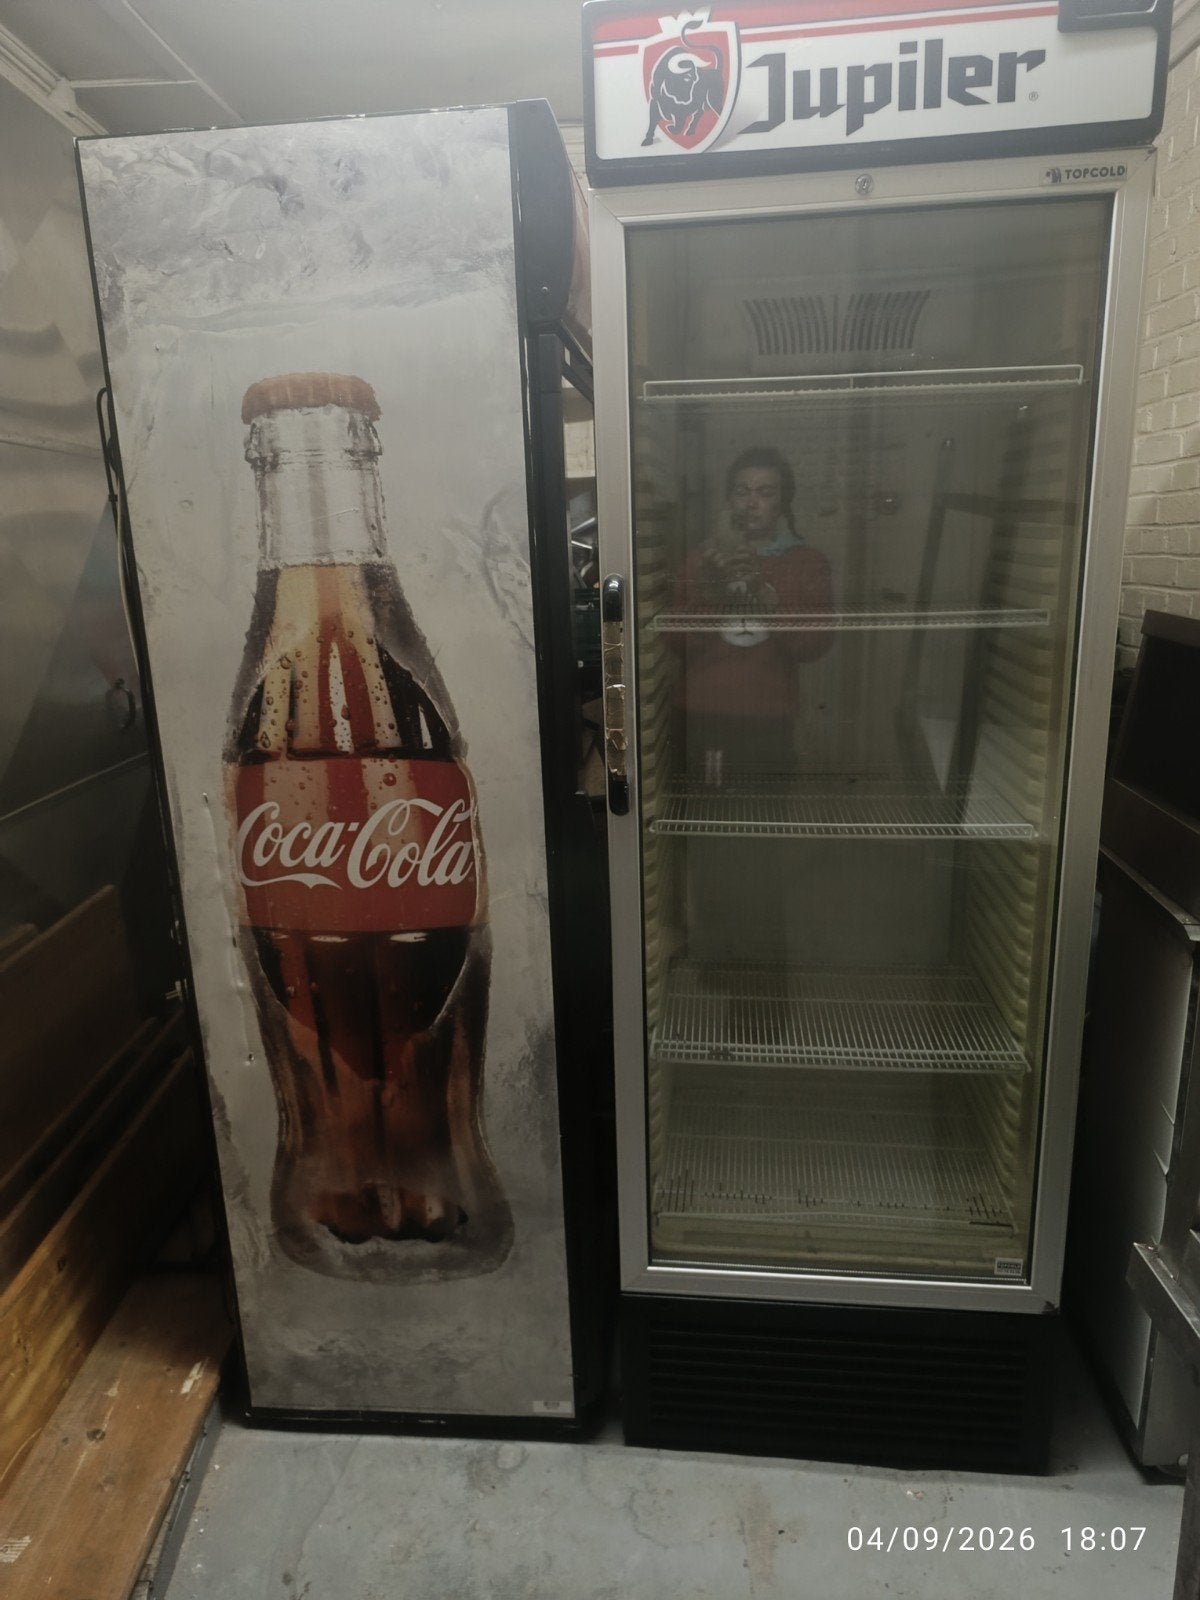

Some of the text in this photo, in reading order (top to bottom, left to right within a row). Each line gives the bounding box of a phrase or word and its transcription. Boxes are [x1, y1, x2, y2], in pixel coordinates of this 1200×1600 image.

[737, 38, 1046, 137] Jupiler
[1065, 165, 1126, 180] TOPCOLD
[238, 798, 474, 890] Coca-Cola
